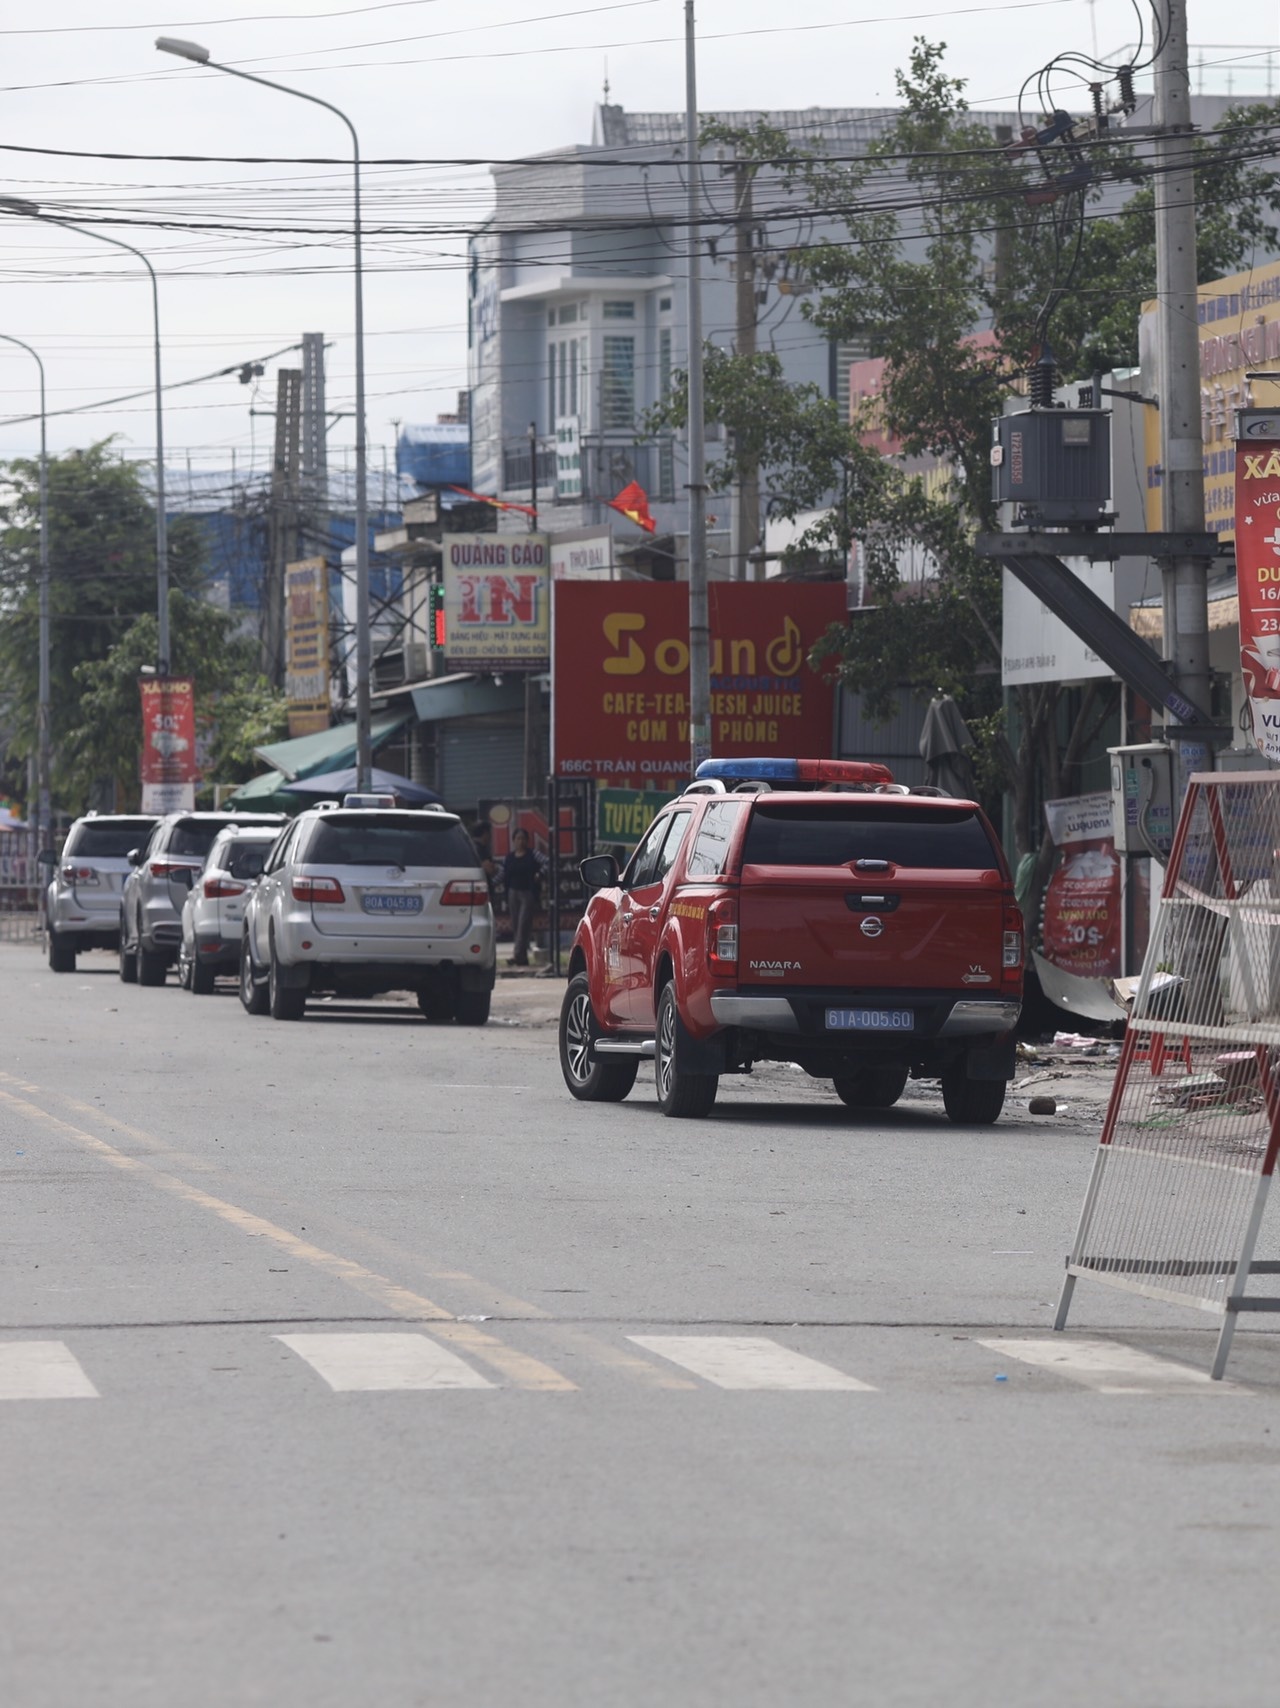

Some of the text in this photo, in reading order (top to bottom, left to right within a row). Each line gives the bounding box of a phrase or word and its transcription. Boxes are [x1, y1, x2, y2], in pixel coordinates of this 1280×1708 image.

[1253, 491, 1280, 507] vừa
[451, 536, 504, 566] QUẢNG
[457, 574, 537, 622] IN
[752, 694, 802, 716] JUICE
[627, 719, 667, 742] CƠM
[719, 714, 778, 742] PHÒNG
[560, 761, 592, 773] 166C
[750, 960, 801, 970] NAVARA
[969, 964, 986, 973] VL
[828, 1009, 911, 1028] 61A-005.60
